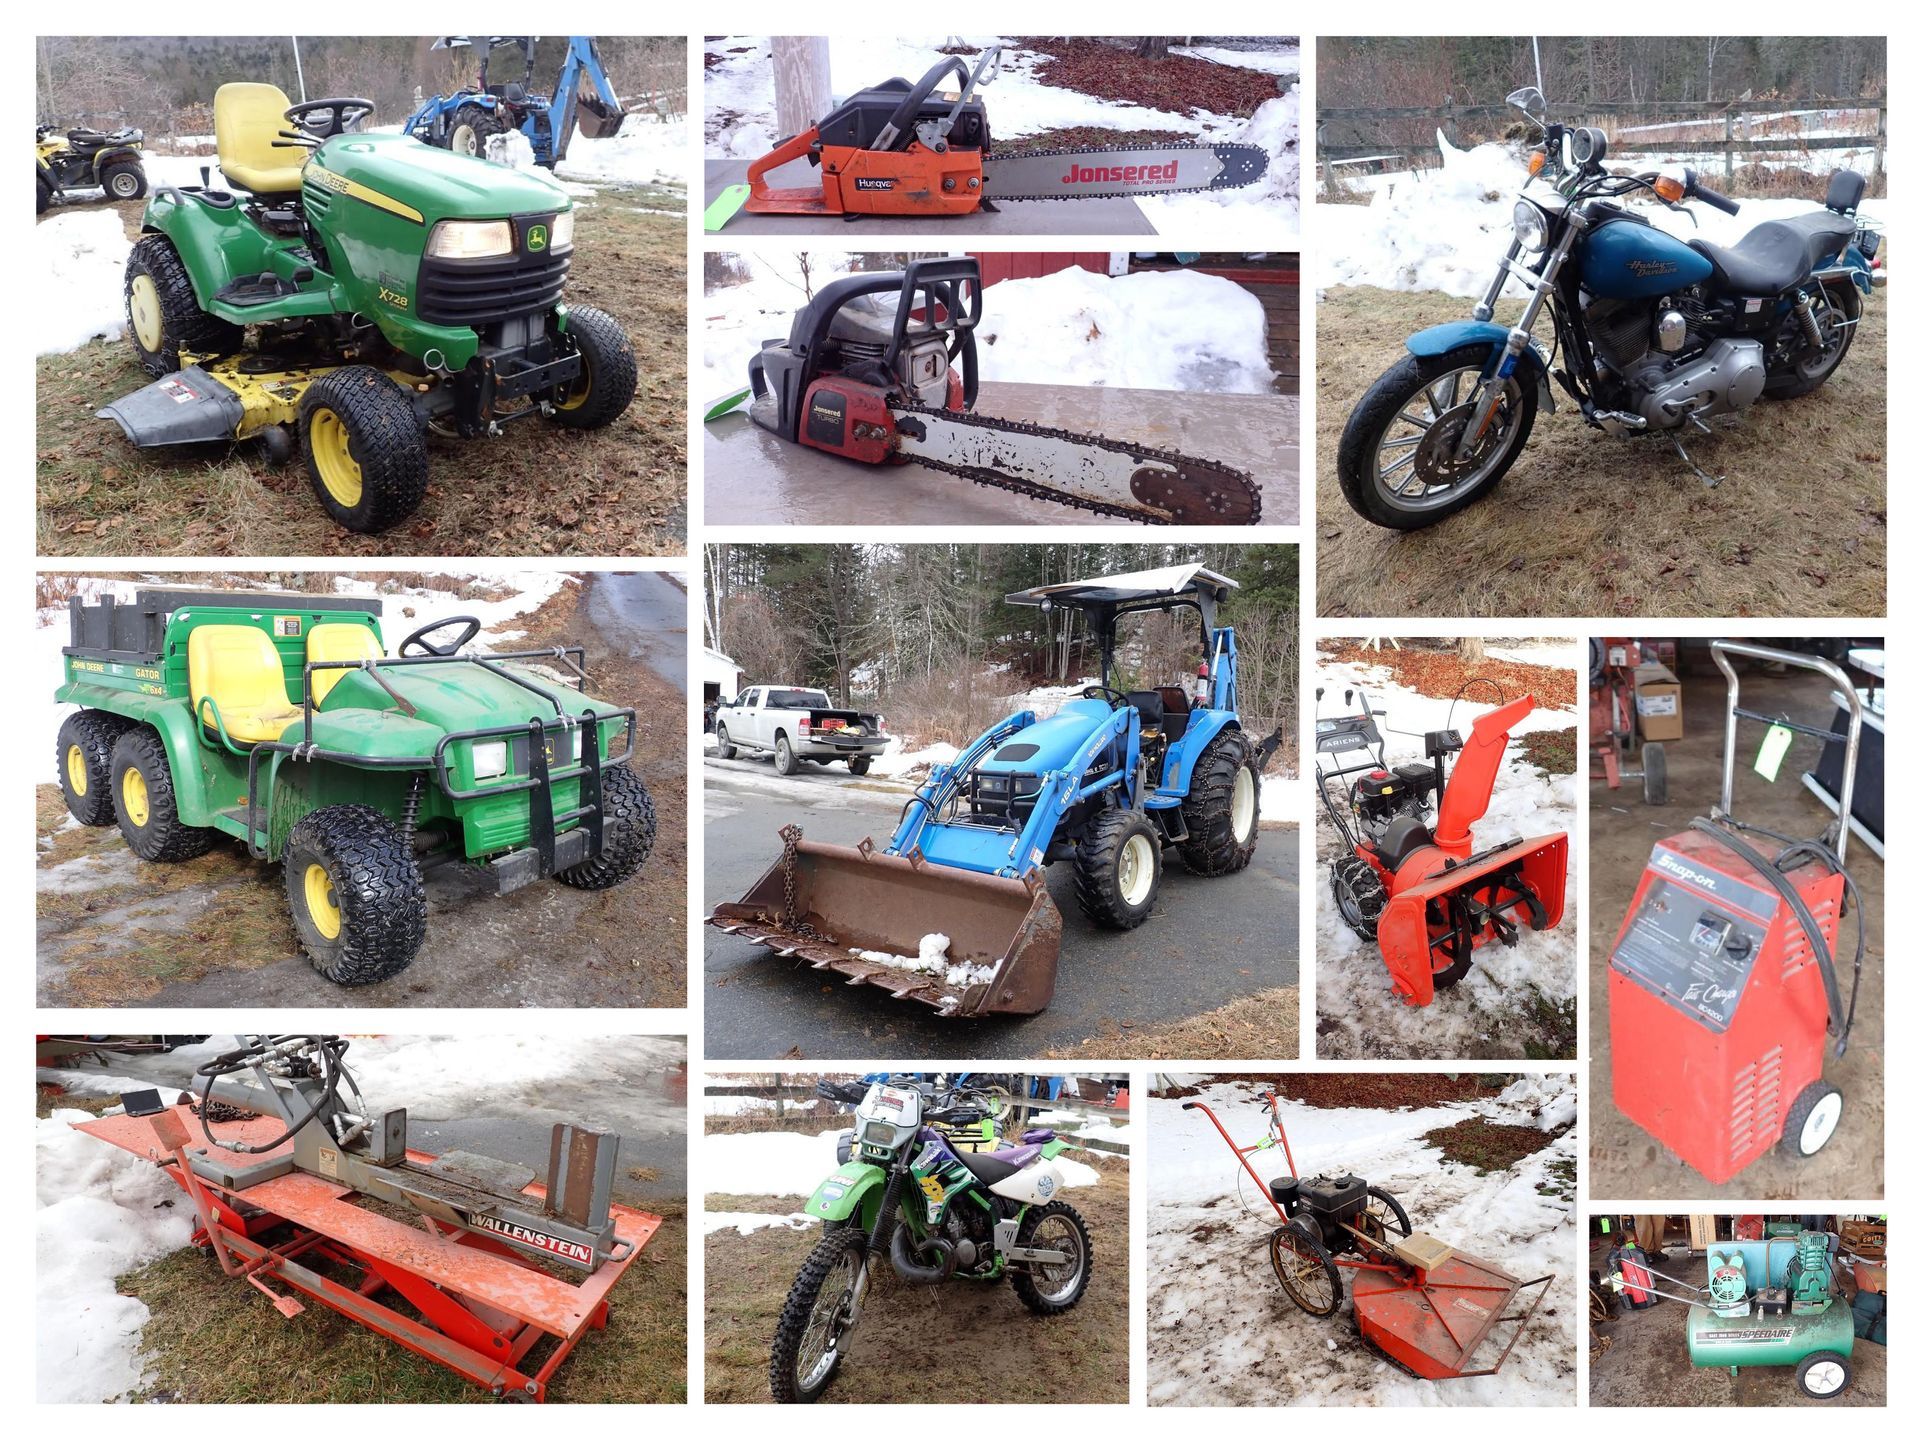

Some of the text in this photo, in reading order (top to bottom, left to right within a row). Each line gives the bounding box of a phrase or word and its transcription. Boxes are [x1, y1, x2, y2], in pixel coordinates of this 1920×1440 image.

[1062, 160, 1178, 184] Jonsered
[324, 172, 349, 193] DEERE
[379, 286, 408, 306] X728
[813, 405, 841, 417] Jonsered
[817, 415, 840, 425] TURBO
[72, 661, 105, 673] JOHN DEERE
[136, 668, 160, 680] GATOR
[1326, 737, 1360, 748] ARIENS
[1657, 854, 1716, 890] Snap-on
[915, 1147, 943, 1171] Kawasaki
[1012, 1146, 1039, 1166] Kawasaki
[471, 1213, 590, 1261] WALLENSTEIN
[1740, 1329, 1793, 1339] SPEEDAIRE
